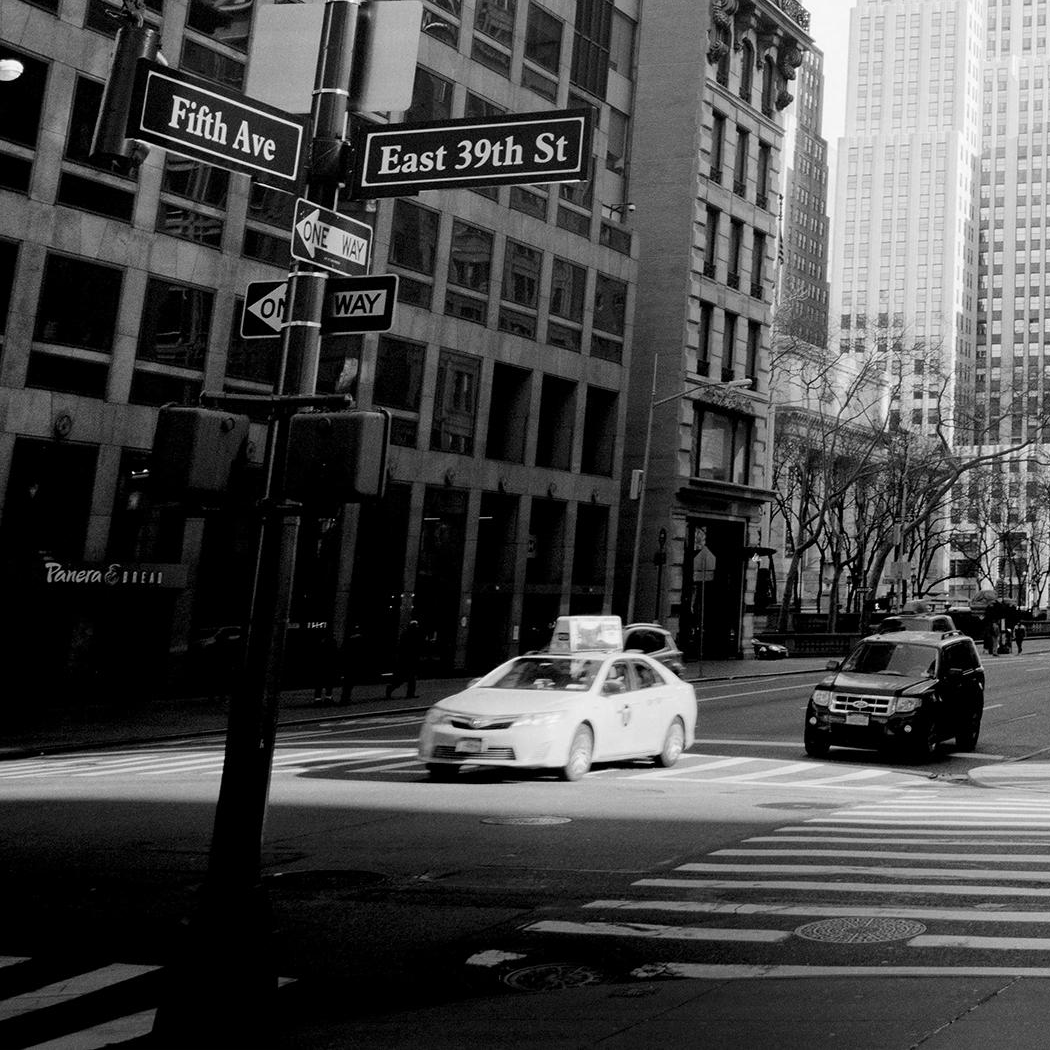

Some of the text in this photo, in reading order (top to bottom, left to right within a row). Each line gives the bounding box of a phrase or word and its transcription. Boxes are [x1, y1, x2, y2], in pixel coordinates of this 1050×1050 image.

[168, 94, 276, 161] Fifth Ave
[378, 132, 568, 175] East 39th St
[303, 220, 365, 261] ONE WAY
[335, 293, 382, 315] WAY
[45, 562, 102, 583] Panera
